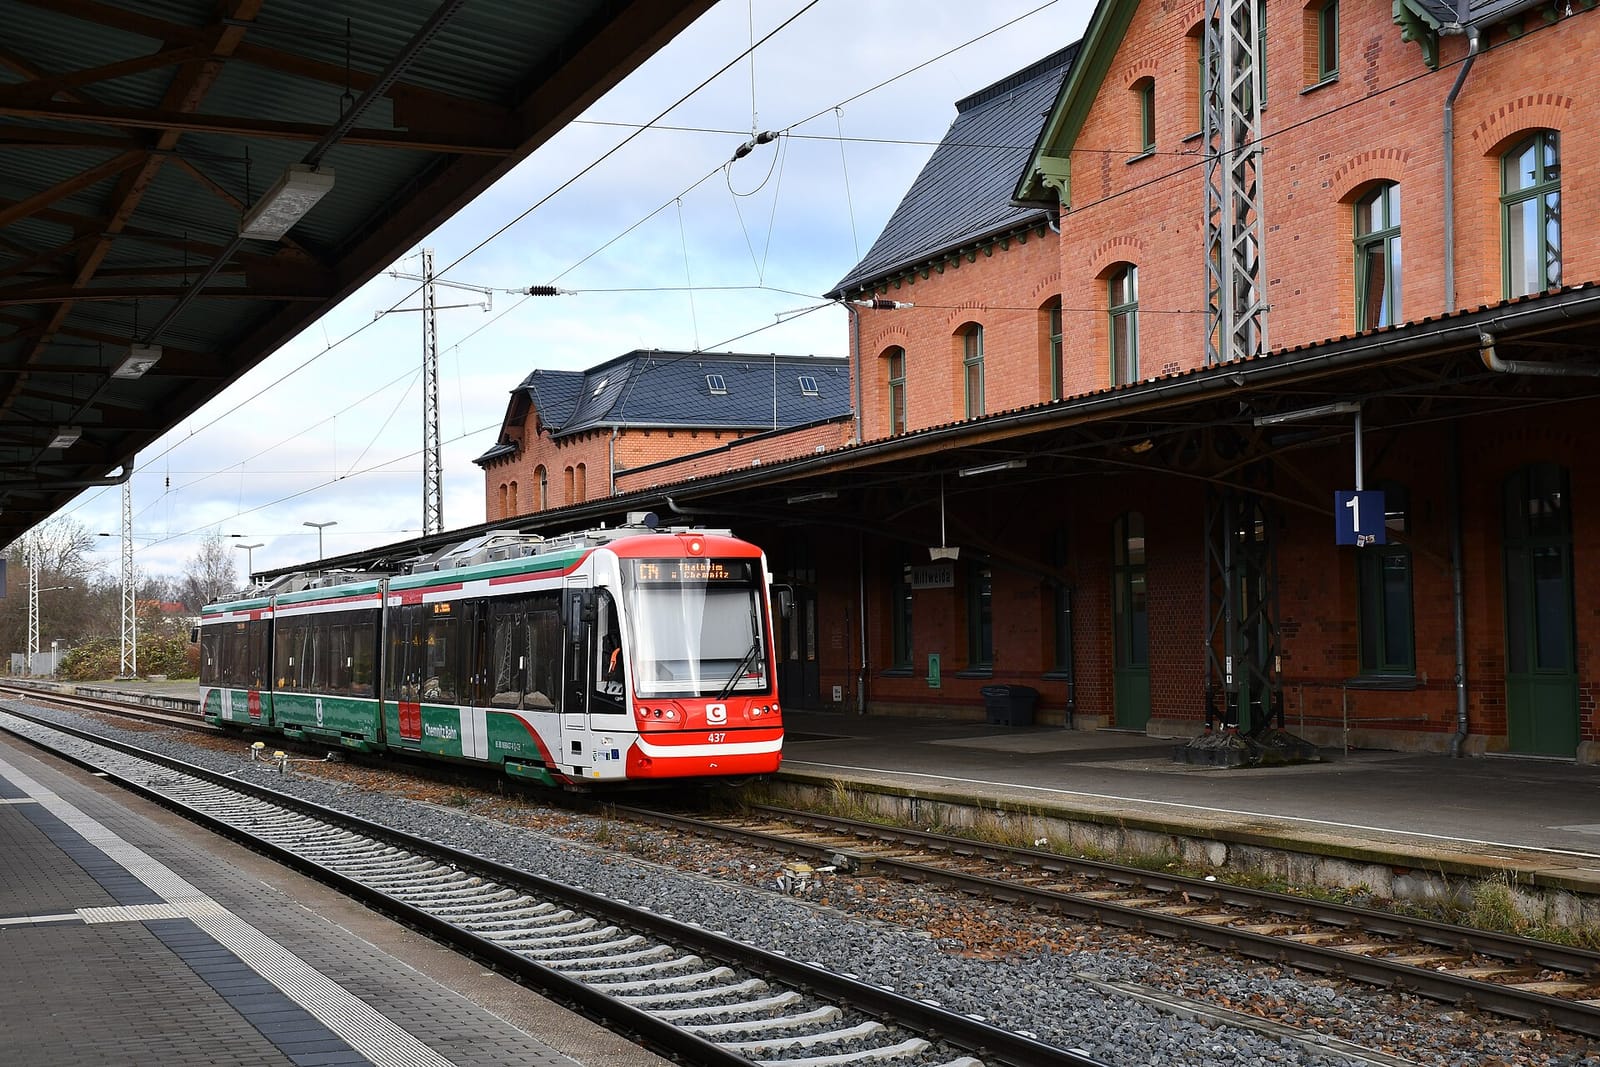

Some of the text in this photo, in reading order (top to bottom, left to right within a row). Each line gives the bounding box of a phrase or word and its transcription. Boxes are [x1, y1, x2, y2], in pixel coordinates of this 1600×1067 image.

[1346, 496, 1359, 532] 1
[639, 563, 659, 580] C14
[678, 563, 723, 571] Thalheim
[683, 571, 729, 579] Chemnitz
[711, 707, 721, 718] C
[707, 733, 726, 743] 437
